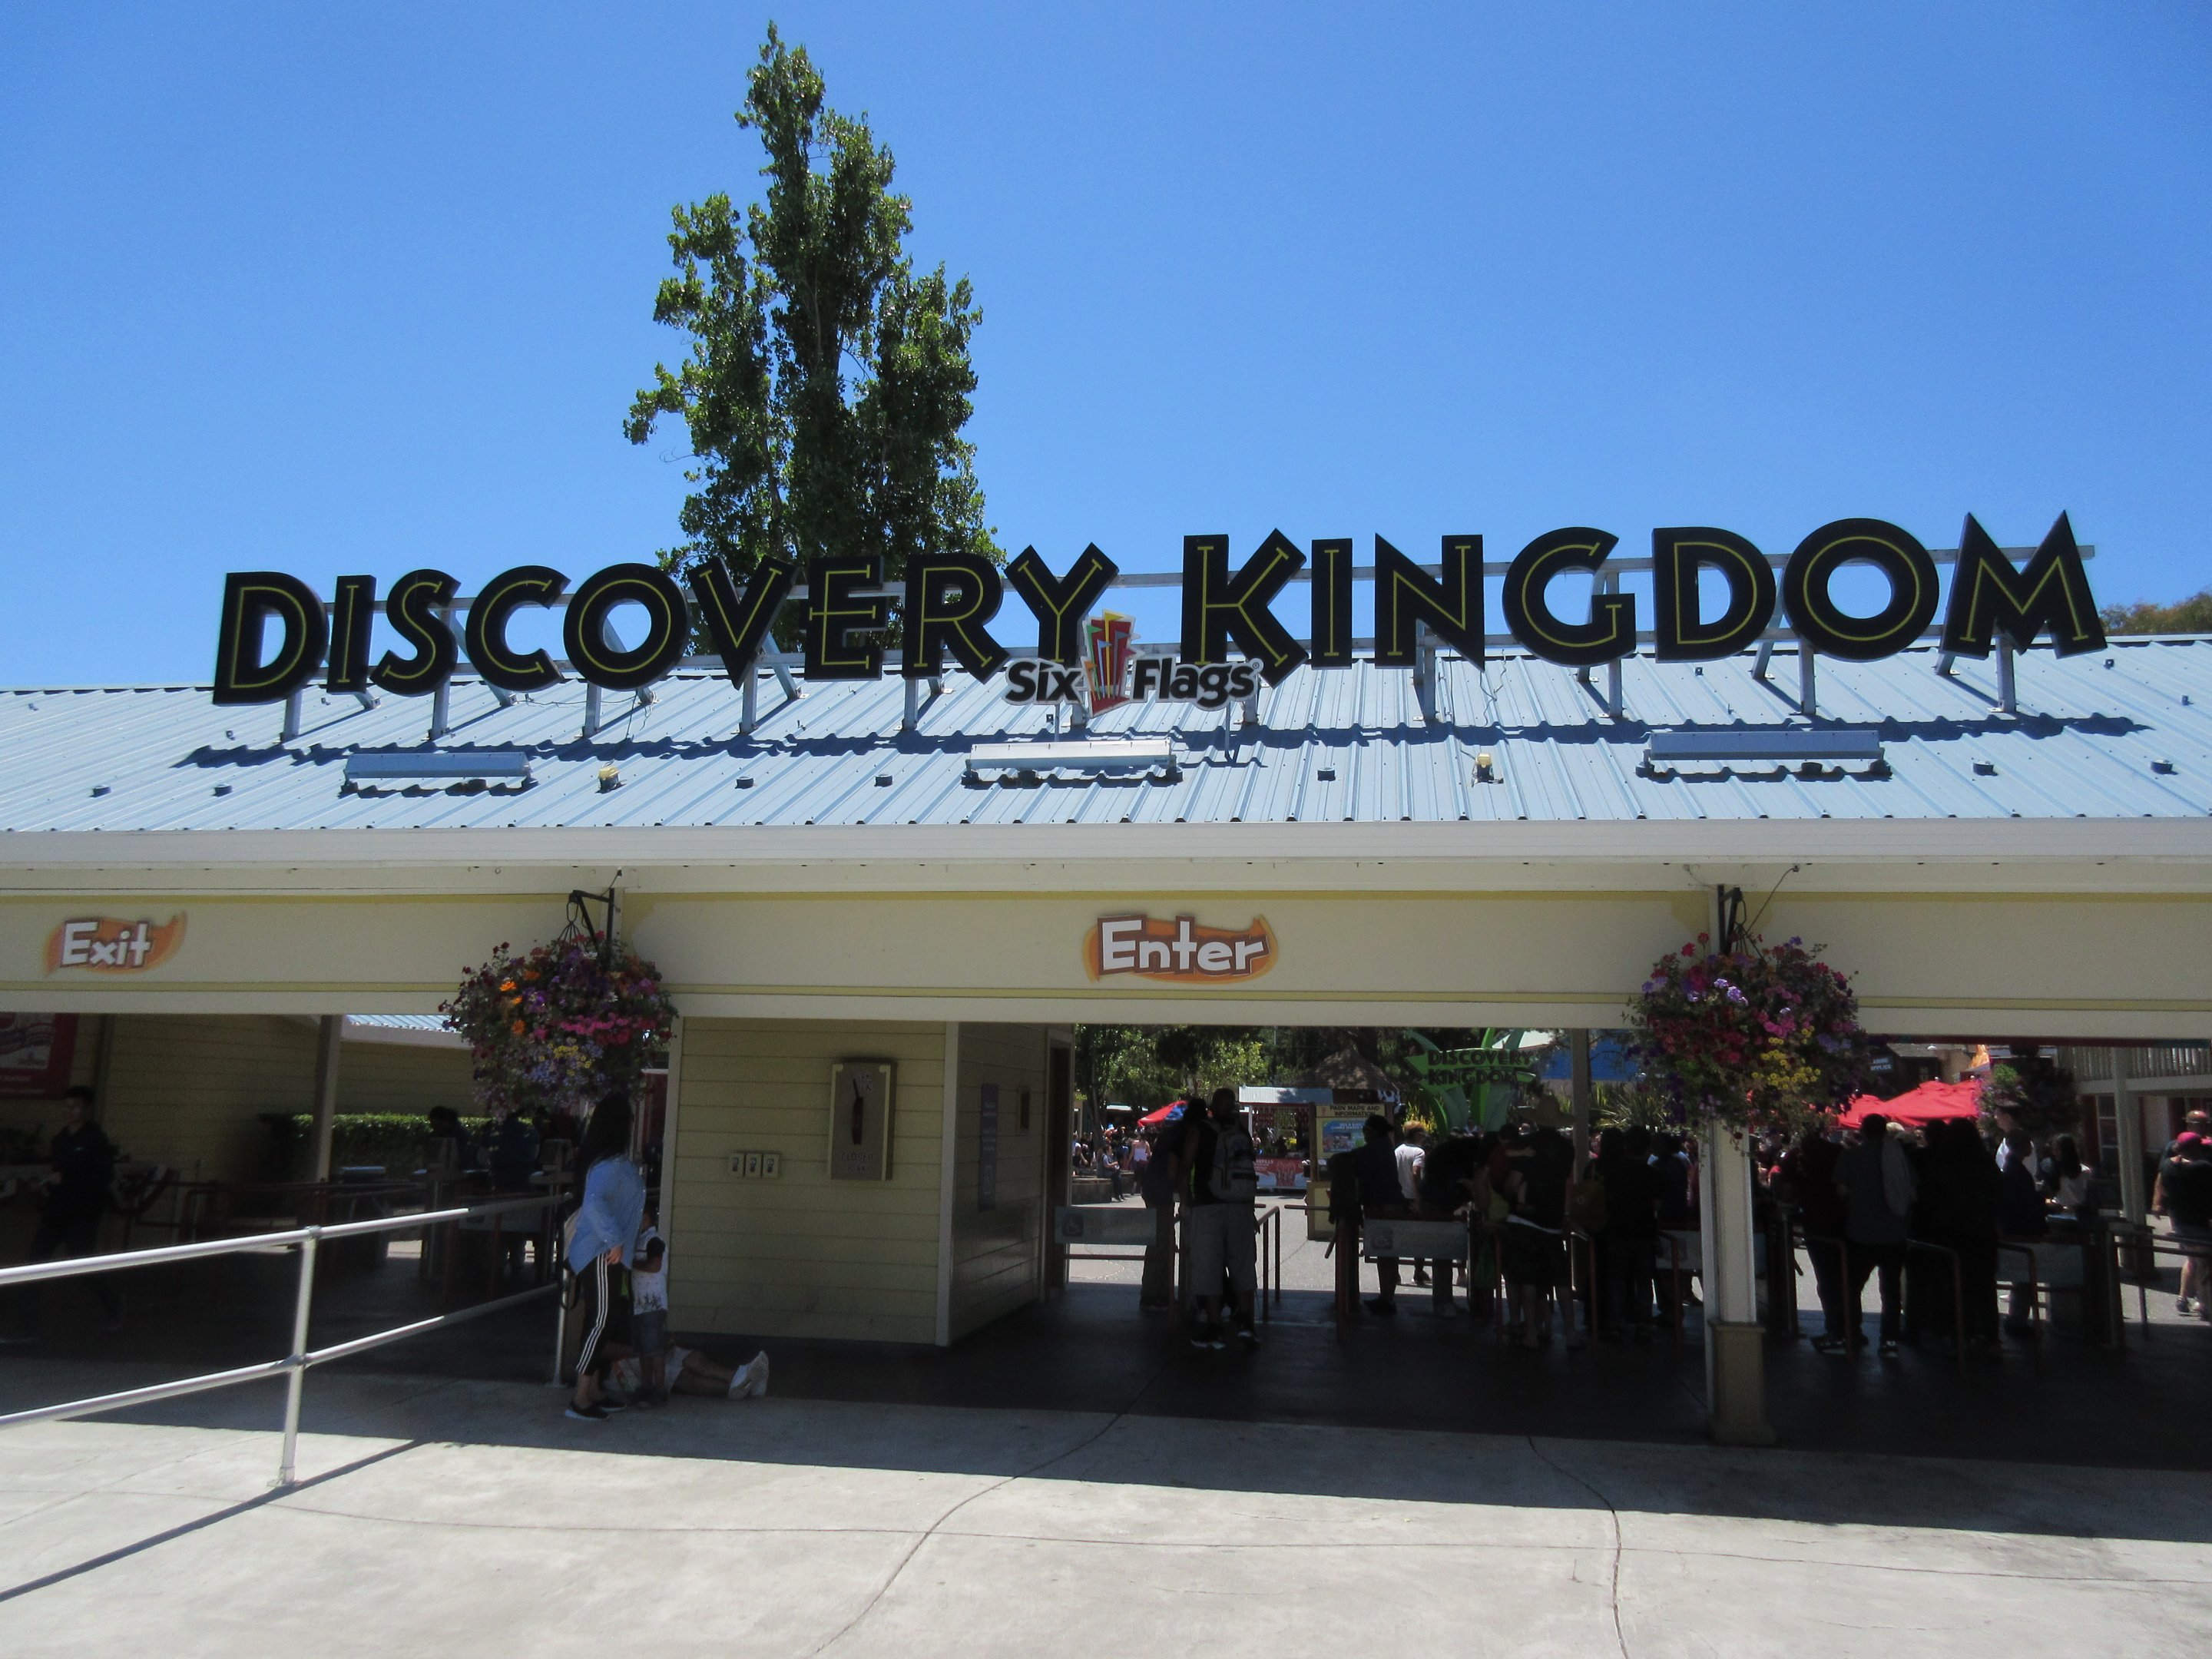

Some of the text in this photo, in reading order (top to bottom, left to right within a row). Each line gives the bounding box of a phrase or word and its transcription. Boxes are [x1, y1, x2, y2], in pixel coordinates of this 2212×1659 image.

[214, 508, 2108, 706] DISCOVERY KINGDOM
[1004, 657, 1257, 709] Six Flags
[61, 920, 153, 967] Exit
[1099, 916, 1267, 974] Enter
[1428, 1049, 1532, 1065] DISCOVERY
[1428, 1068, 1520, 1085] KINGDOM
[841, 1152, 873, 1161] CLOSED
